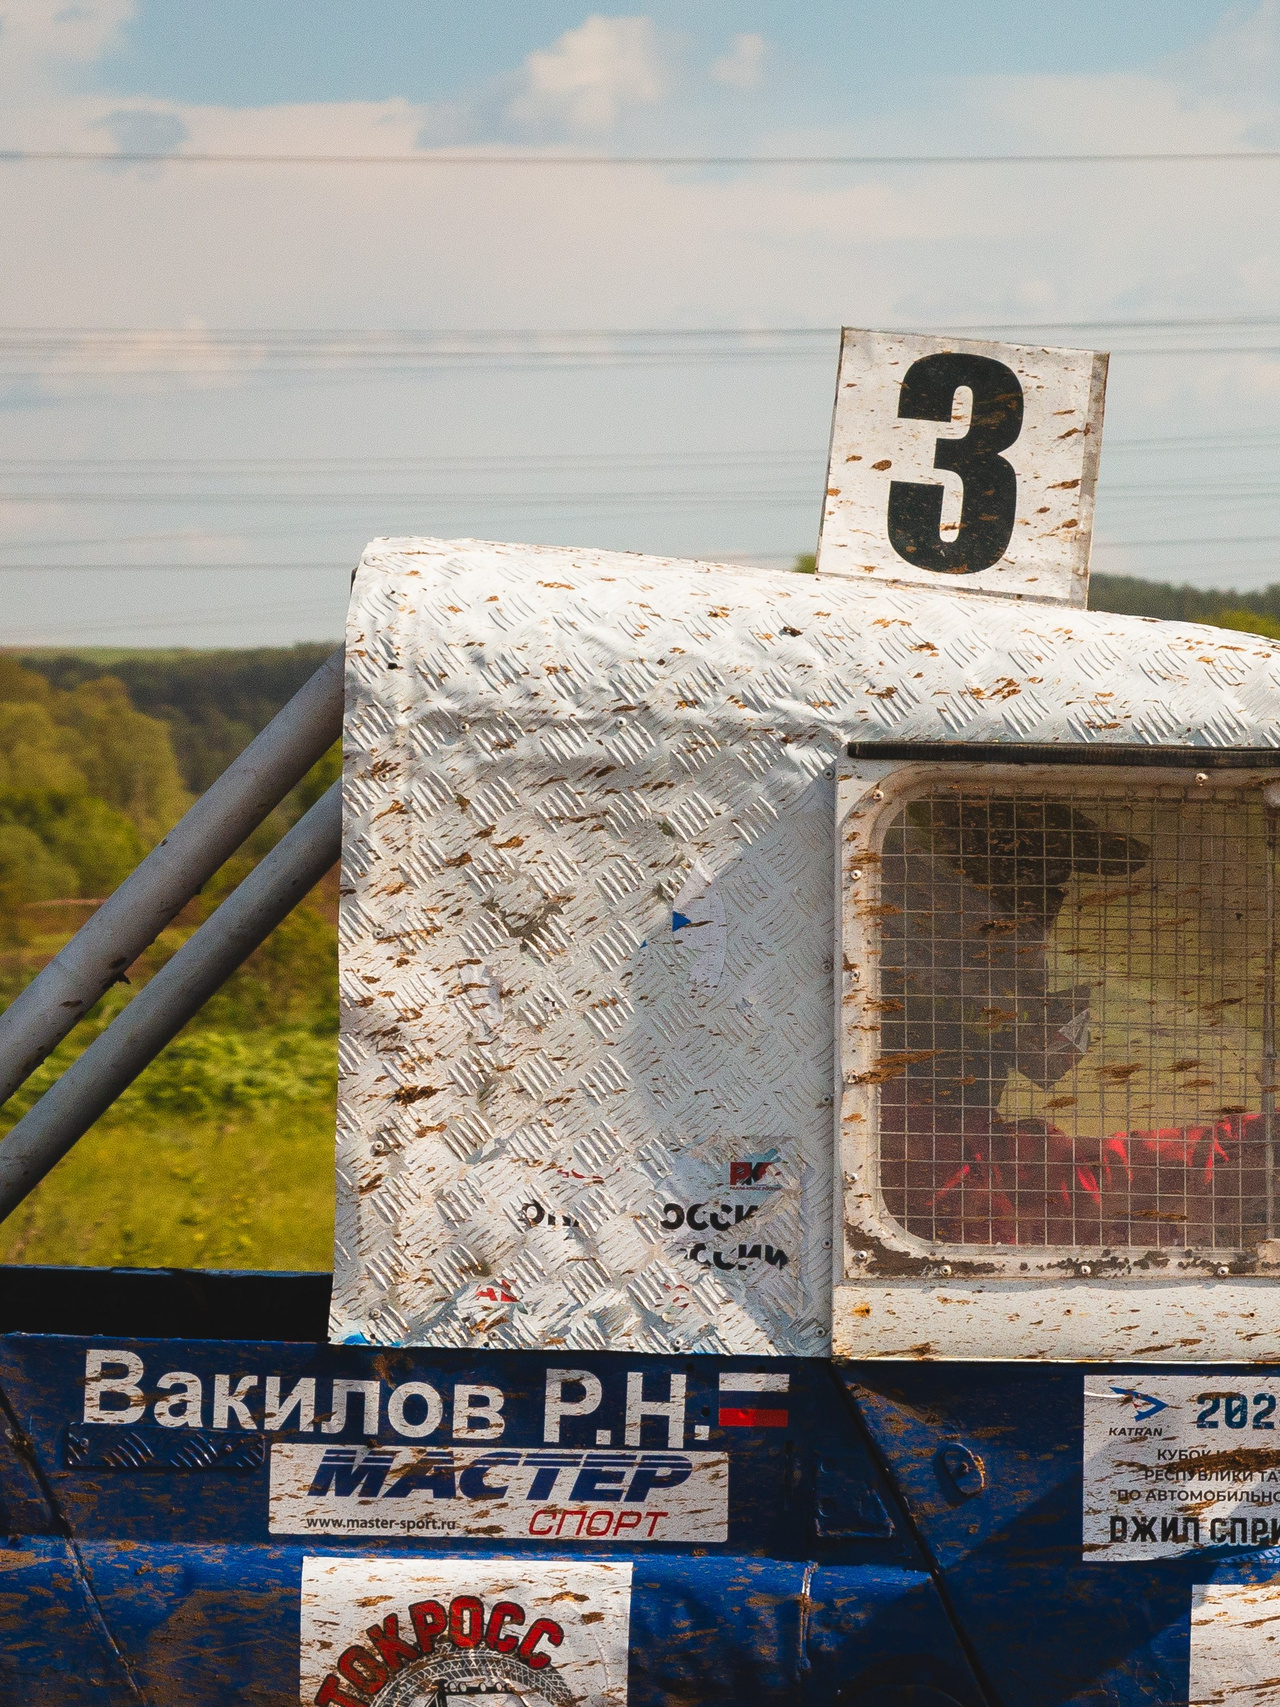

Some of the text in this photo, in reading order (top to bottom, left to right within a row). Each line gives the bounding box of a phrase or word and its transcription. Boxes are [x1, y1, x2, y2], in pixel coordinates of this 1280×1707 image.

[887, 352, 1024, 575] 3
[84, 1349, 710, 1449] Вакилов Р.Н.
[1109, 1427, 1163, 1437] KATRAN
[307, 1449, 693, 1503] МАСТЕР
[1117, 1489, 1141, 1501] ПО
[307, 1518, 457, 1532] www.master-sport.ru
[528, 1509, 669, 1538] СПОРТ
